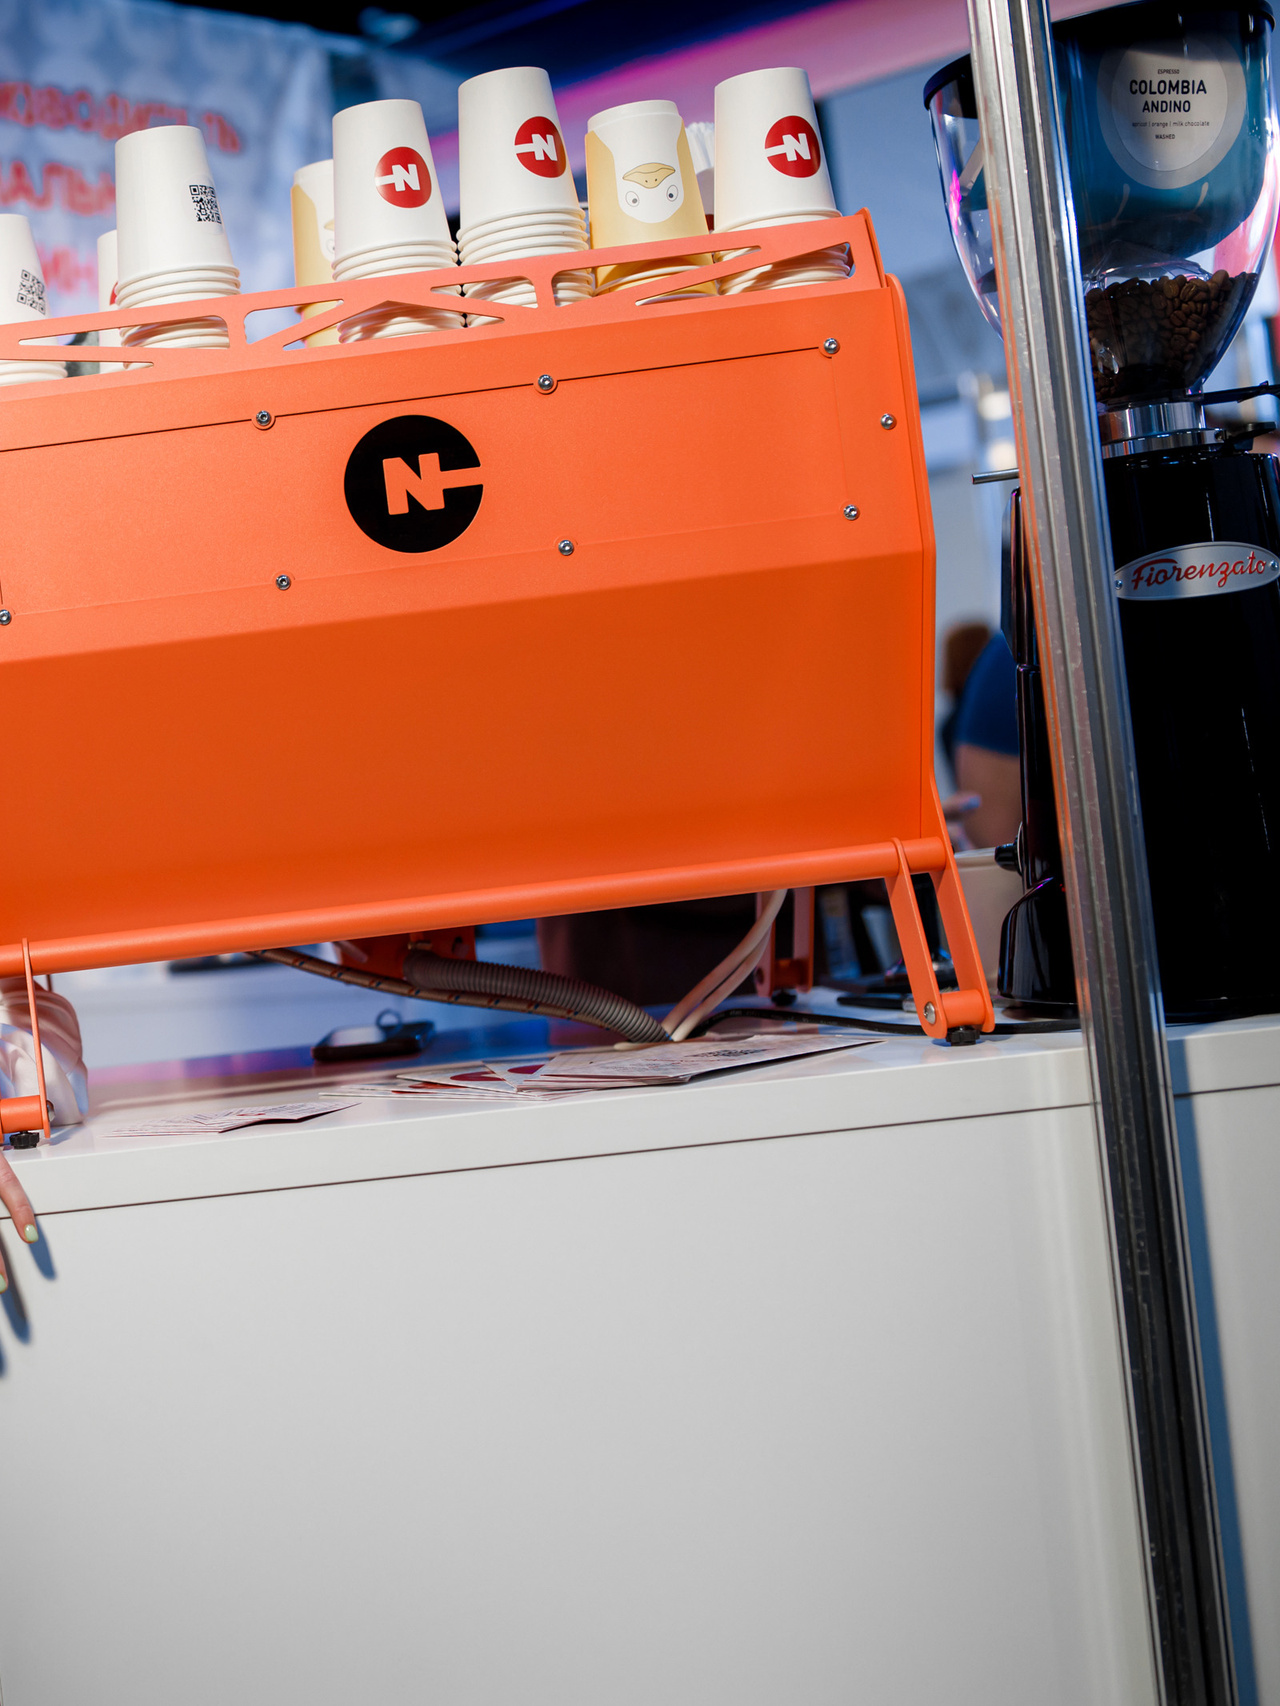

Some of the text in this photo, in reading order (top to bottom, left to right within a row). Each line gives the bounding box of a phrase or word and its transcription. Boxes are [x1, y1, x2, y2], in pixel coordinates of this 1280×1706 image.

[1129, 80, 1207, 94] COLOMBIA
[1142, 100, 1191, 113] ANDINO
[1131, 550, 1267, 590] Fiorenzato
